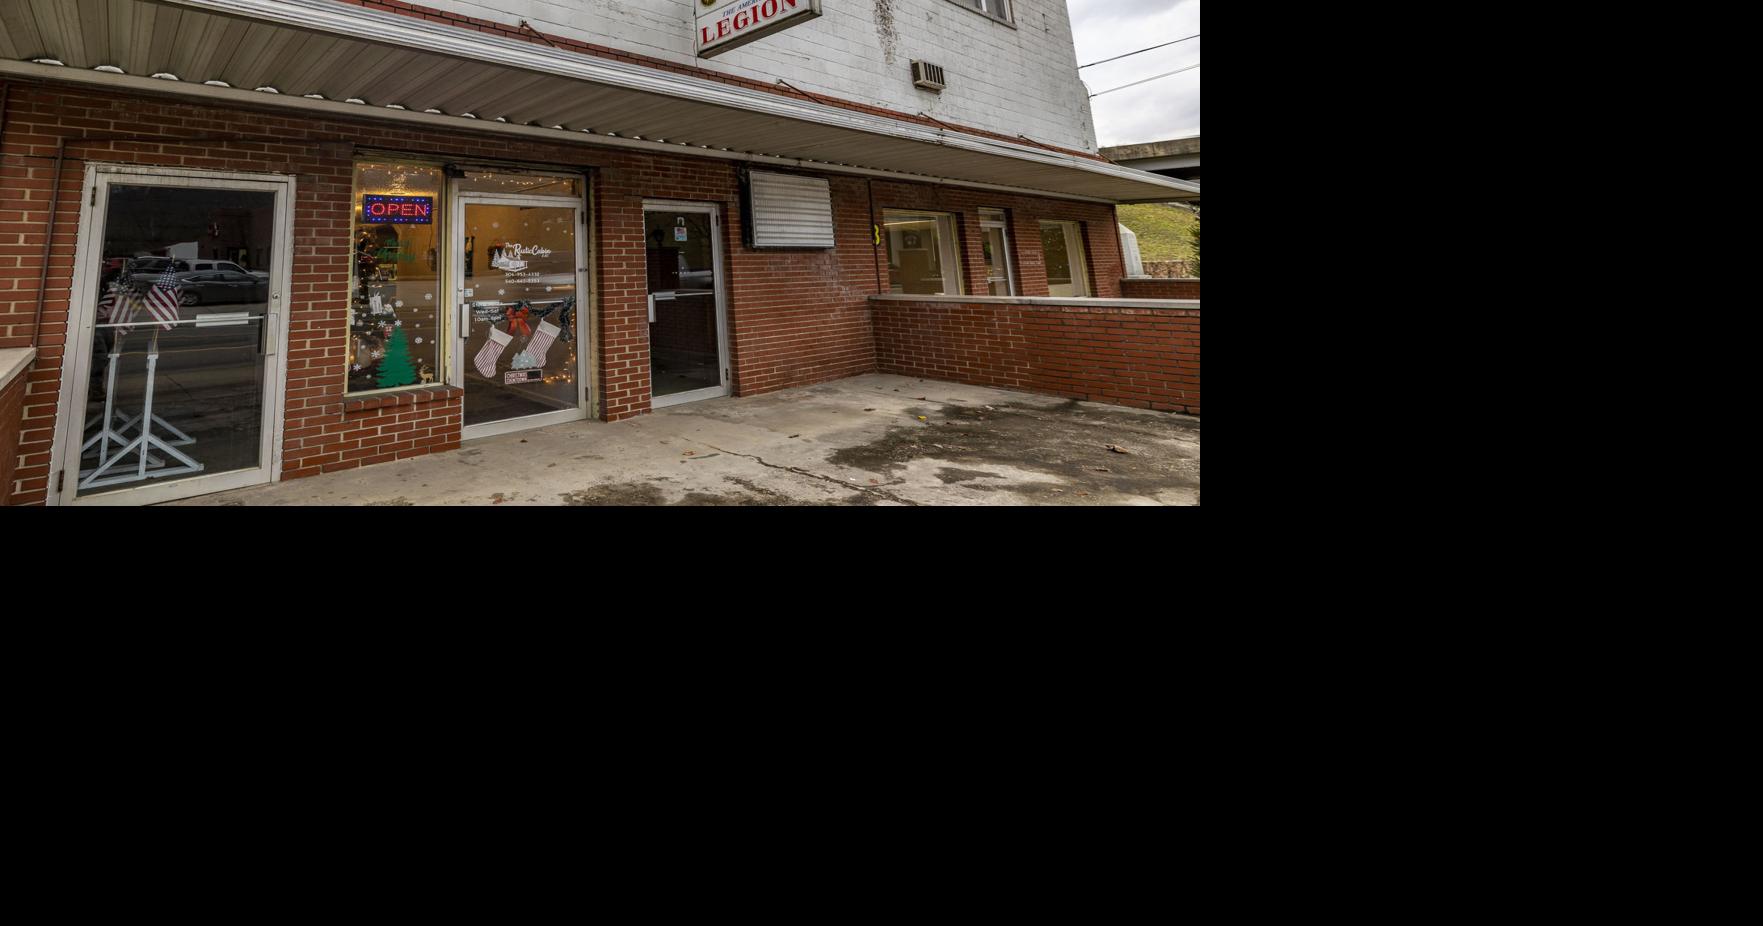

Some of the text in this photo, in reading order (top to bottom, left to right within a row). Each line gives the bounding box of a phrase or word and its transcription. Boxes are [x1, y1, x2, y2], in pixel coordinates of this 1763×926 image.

[723, 7, 736, 17] THE
[702, 0, 797, 44] LEGION
[371, 203, 427, 216] OPEN
